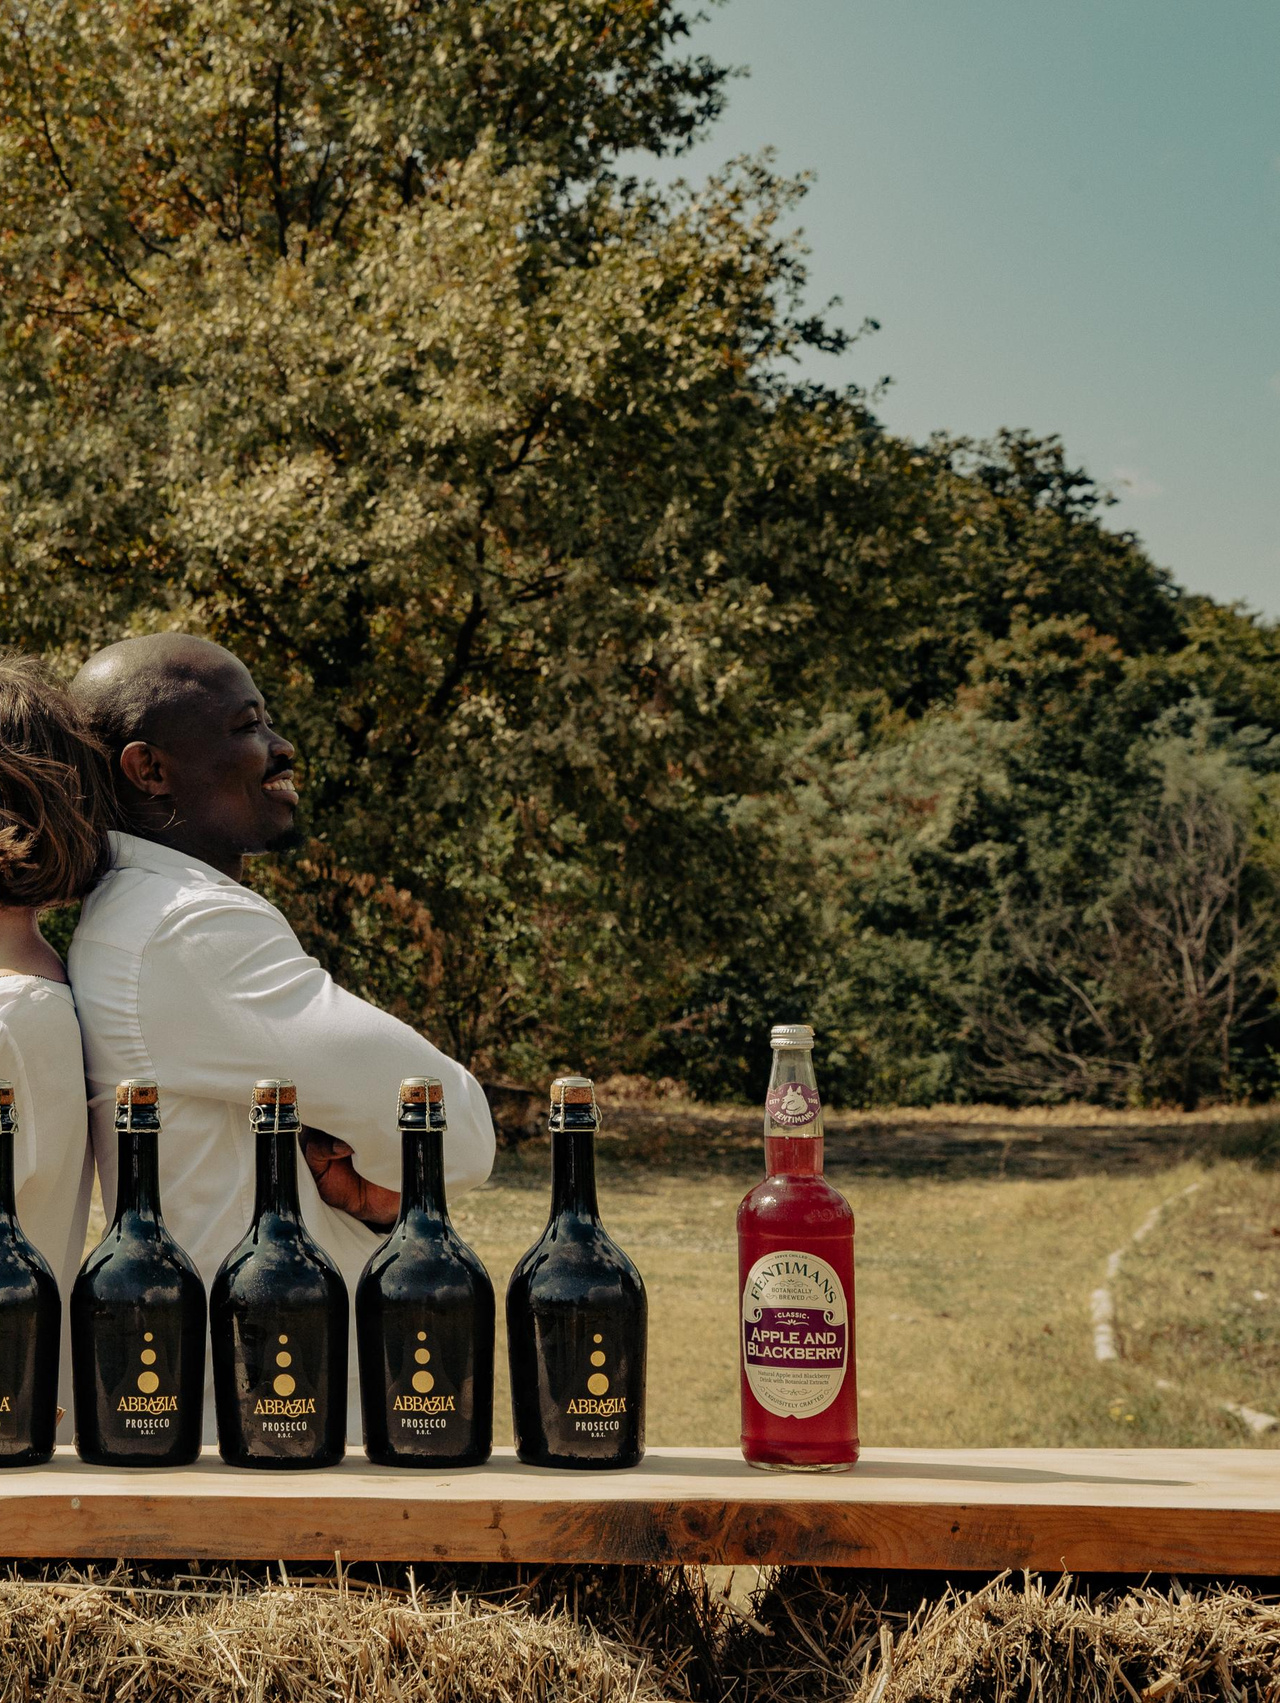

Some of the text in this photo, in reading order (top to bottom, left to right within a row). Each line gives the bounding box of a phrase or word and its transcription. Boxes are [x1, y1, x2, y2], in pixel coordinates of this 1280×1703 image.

[774, 1110, 814, 1123] FENTIMANS
[751, 1261, 836, 1303] FENTIMANS
[751, 1327, 836, 1344] APPLE AND
[747, 1341, 842, 1360] BLACKBERRY
[117, 1396, 178, 1415] ABBAZIA
[254, 1398, 316, 1417] ABBAZIA
[393, 1395, 456, 1415] ABBAZIA
[566, 1397, 627, 1417] ABBAZIA
[765, 1392, 824, 1408] EXQUISITELY CRAFTED
[125, 1418, 170, 1429] PROSECCO
[262, 1421, 307, 1432] PROSECCO
[401, 1418, 447, 1429] PROSECCO
[575, 1421, 619, 1431] PROSECCO
